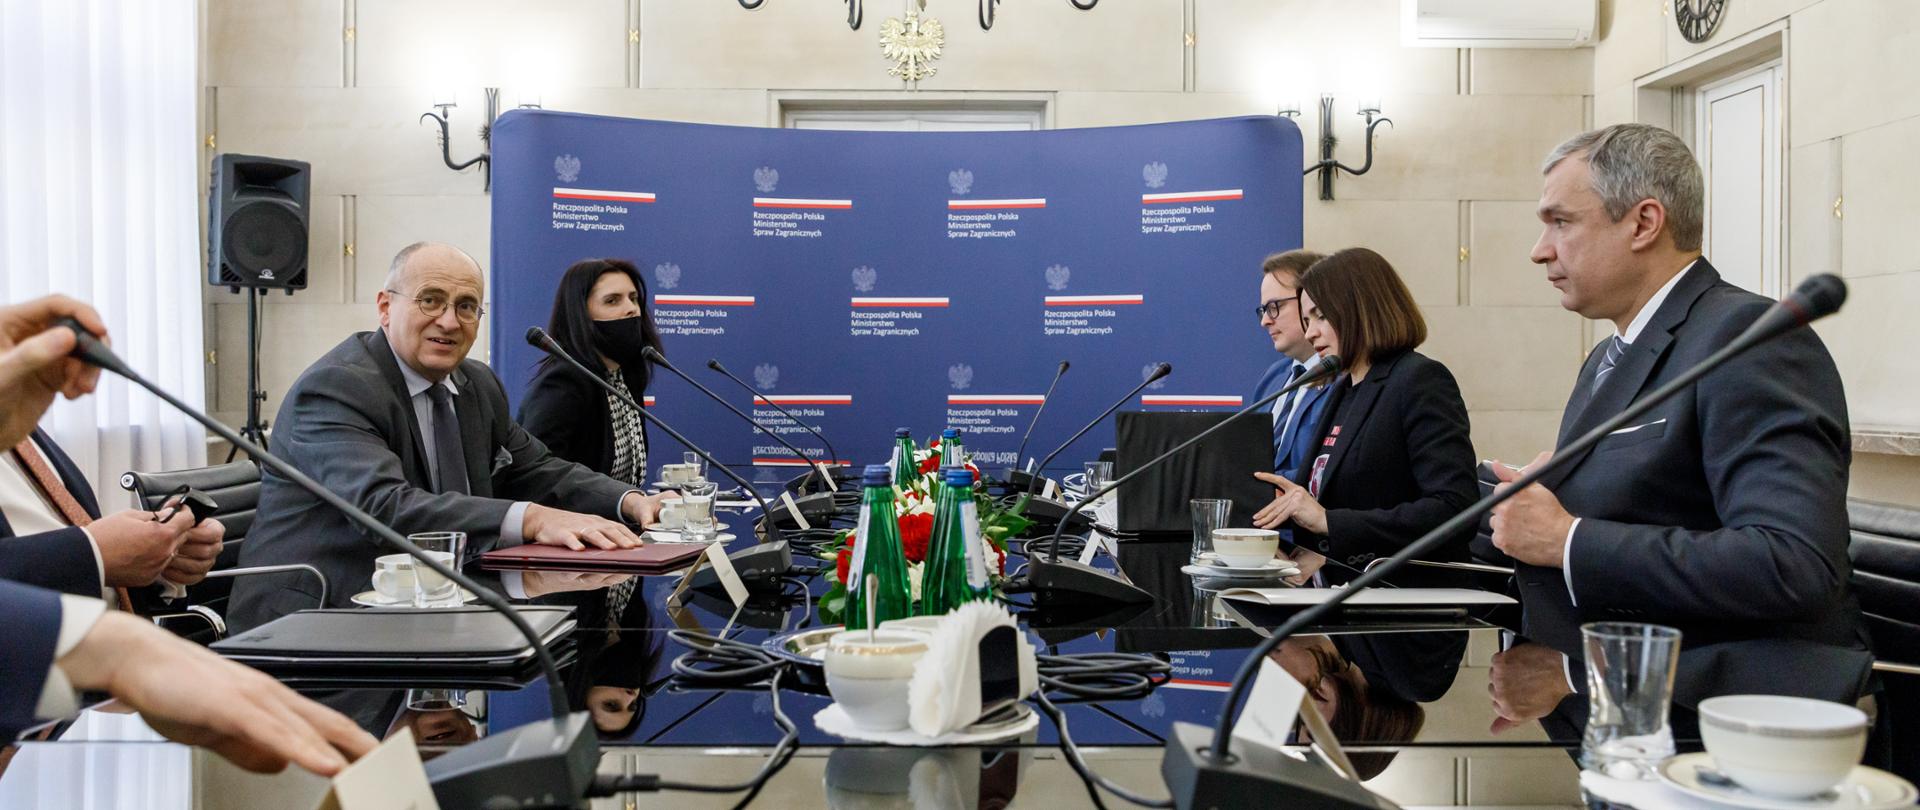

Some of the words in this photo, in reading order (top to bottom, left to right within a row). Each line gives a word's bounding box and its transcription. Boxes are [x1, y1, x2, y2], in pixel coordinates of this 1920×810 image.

[553, 203, 604, 213] Rzeczpospolita
[606, 205, 628, 214] Polska
[1142, 207, 1192, 216] Rzeczpospolita
[1193, 205, 1214, 214] Polska
[553, 212, 599, 221] Ministerstwo
[754, 212, 802, 221] Rzeczpospolita
[804, 212, 824, 220] Polska
[948, 213, 996, 222] Rzeczpospolita
[998, 212, 1018, 220] Polska
[1142, 216, 1186, 224] Ministerstwo
[552, 220, 574, 229] Spraw
[576, 222, 624, 232] Zagranicznych
[754, 220, 797, 228] Ministerstwo
[1142, 226, 1162, 234] Spraw
[1164, 223, 1212, 234] Zagranicznych
[753, 228, 774, 236] Spraw
[776, 228, 822, 238] Zagranicznych
[948, 230, 968, 238] Spraw
[970, 230, 1016, 239] Zagranicznych
[654, 309, 704, 318] Rzeczpospolita
[706, 310, 727, 318] Polska
[851, 311, 899, 320] Rzeczpospolita
[901, 311, 922, 319] Polska
[1044, 310, 1093, 318] Rzeczpospolita
[676, 326, 724, 336] Zagranicznych
[851, 328, 871, 336] Spraw
[872, 328, 919, 336] Zagranicznych
[1044, 327, 1065, 335] Spraw
[1066, 326, 1112, 335] Zagranicznych
[947, 409, 995, 417] Rzeczpospolita
[997, 408, 1018, 416] Polska
[969, 425, 1015, 434] Zagranicznych
